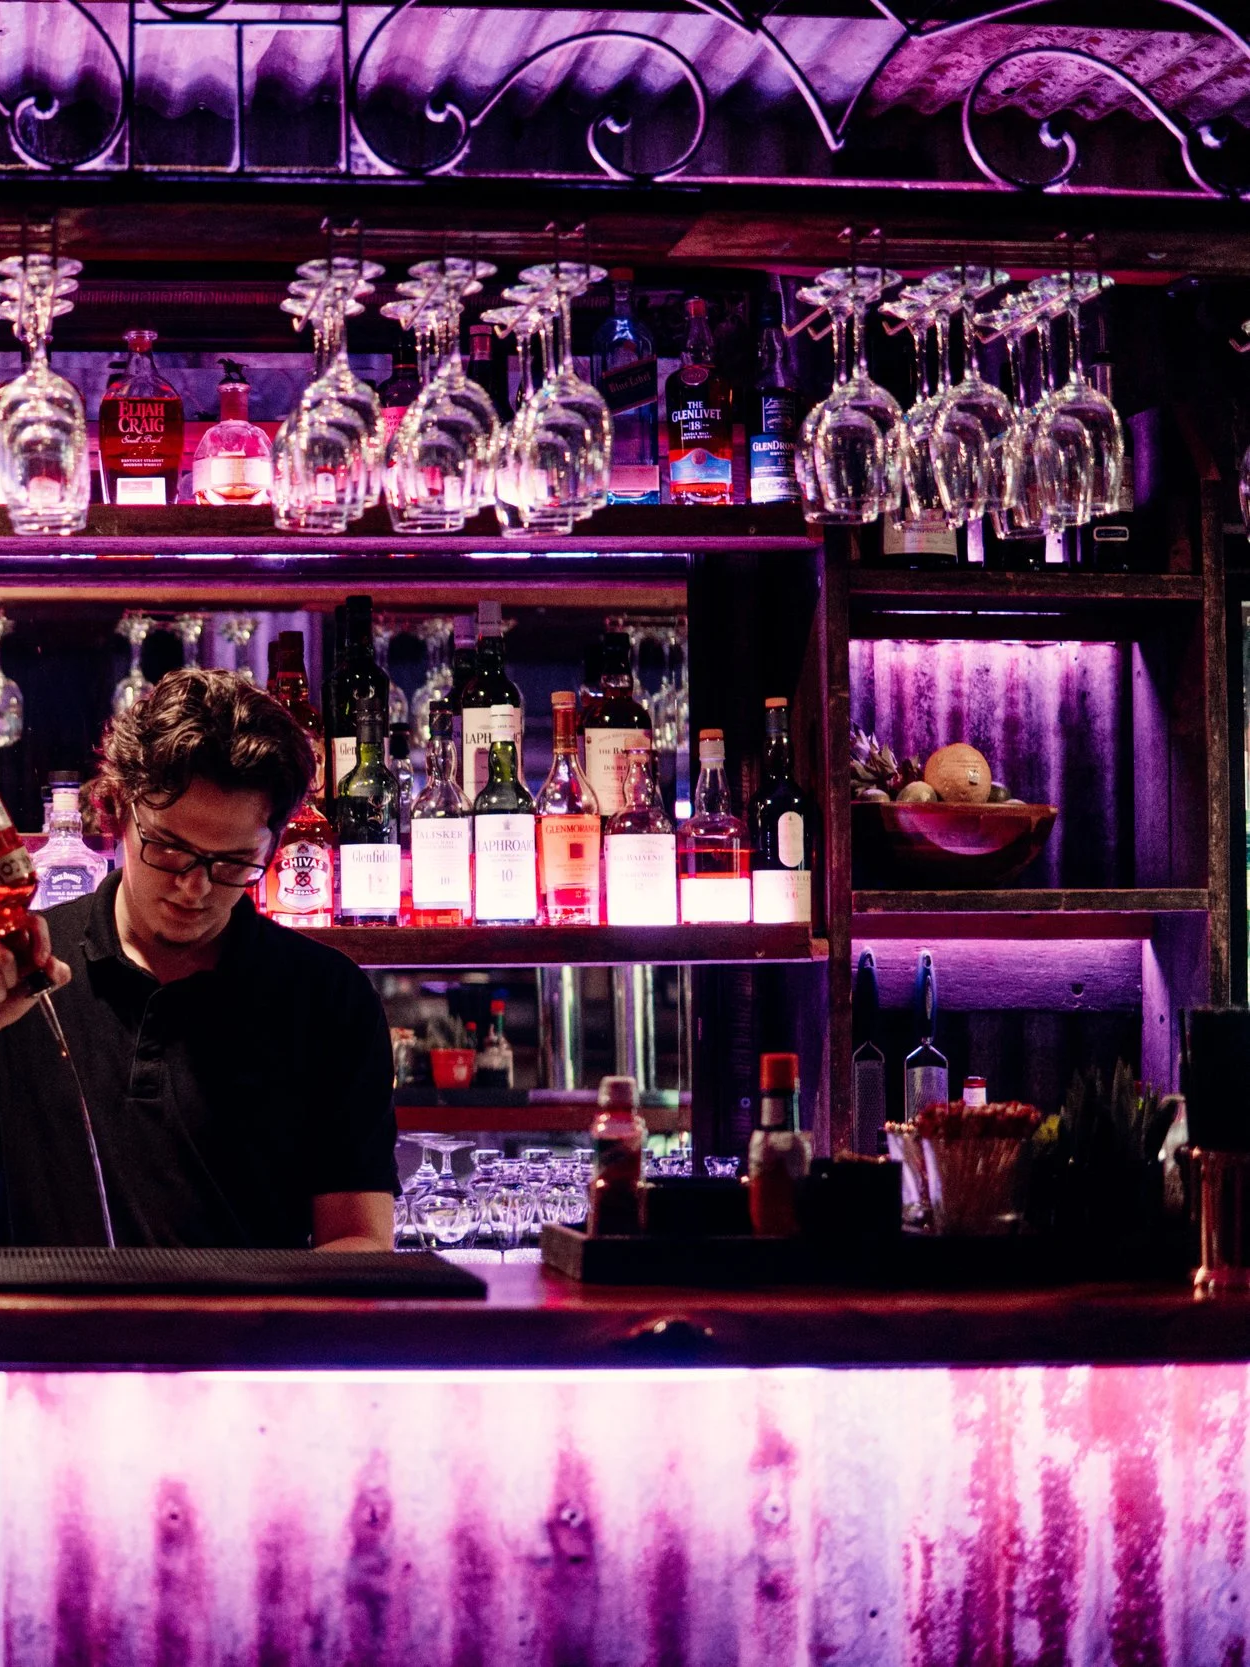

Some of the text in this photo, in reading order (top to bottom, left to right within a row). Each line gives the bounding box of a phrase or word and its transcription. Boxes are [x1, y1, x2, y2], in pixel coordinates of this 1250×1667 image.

[118, 401, 166, 419] ELIJAH
[687, 401, 704, 409] THE
[671, 408, 721, 422] GLENLIVET
[118, 417, 166, 435] CRAIG
[690, 421, 701, 430] 18
[465, 731, 521, 744] LAPHIG
[415, 830, 463, 839] TALISKER
[281, 857, 324, 869] CHIVAS
[501, 868, 513, 882] 10
